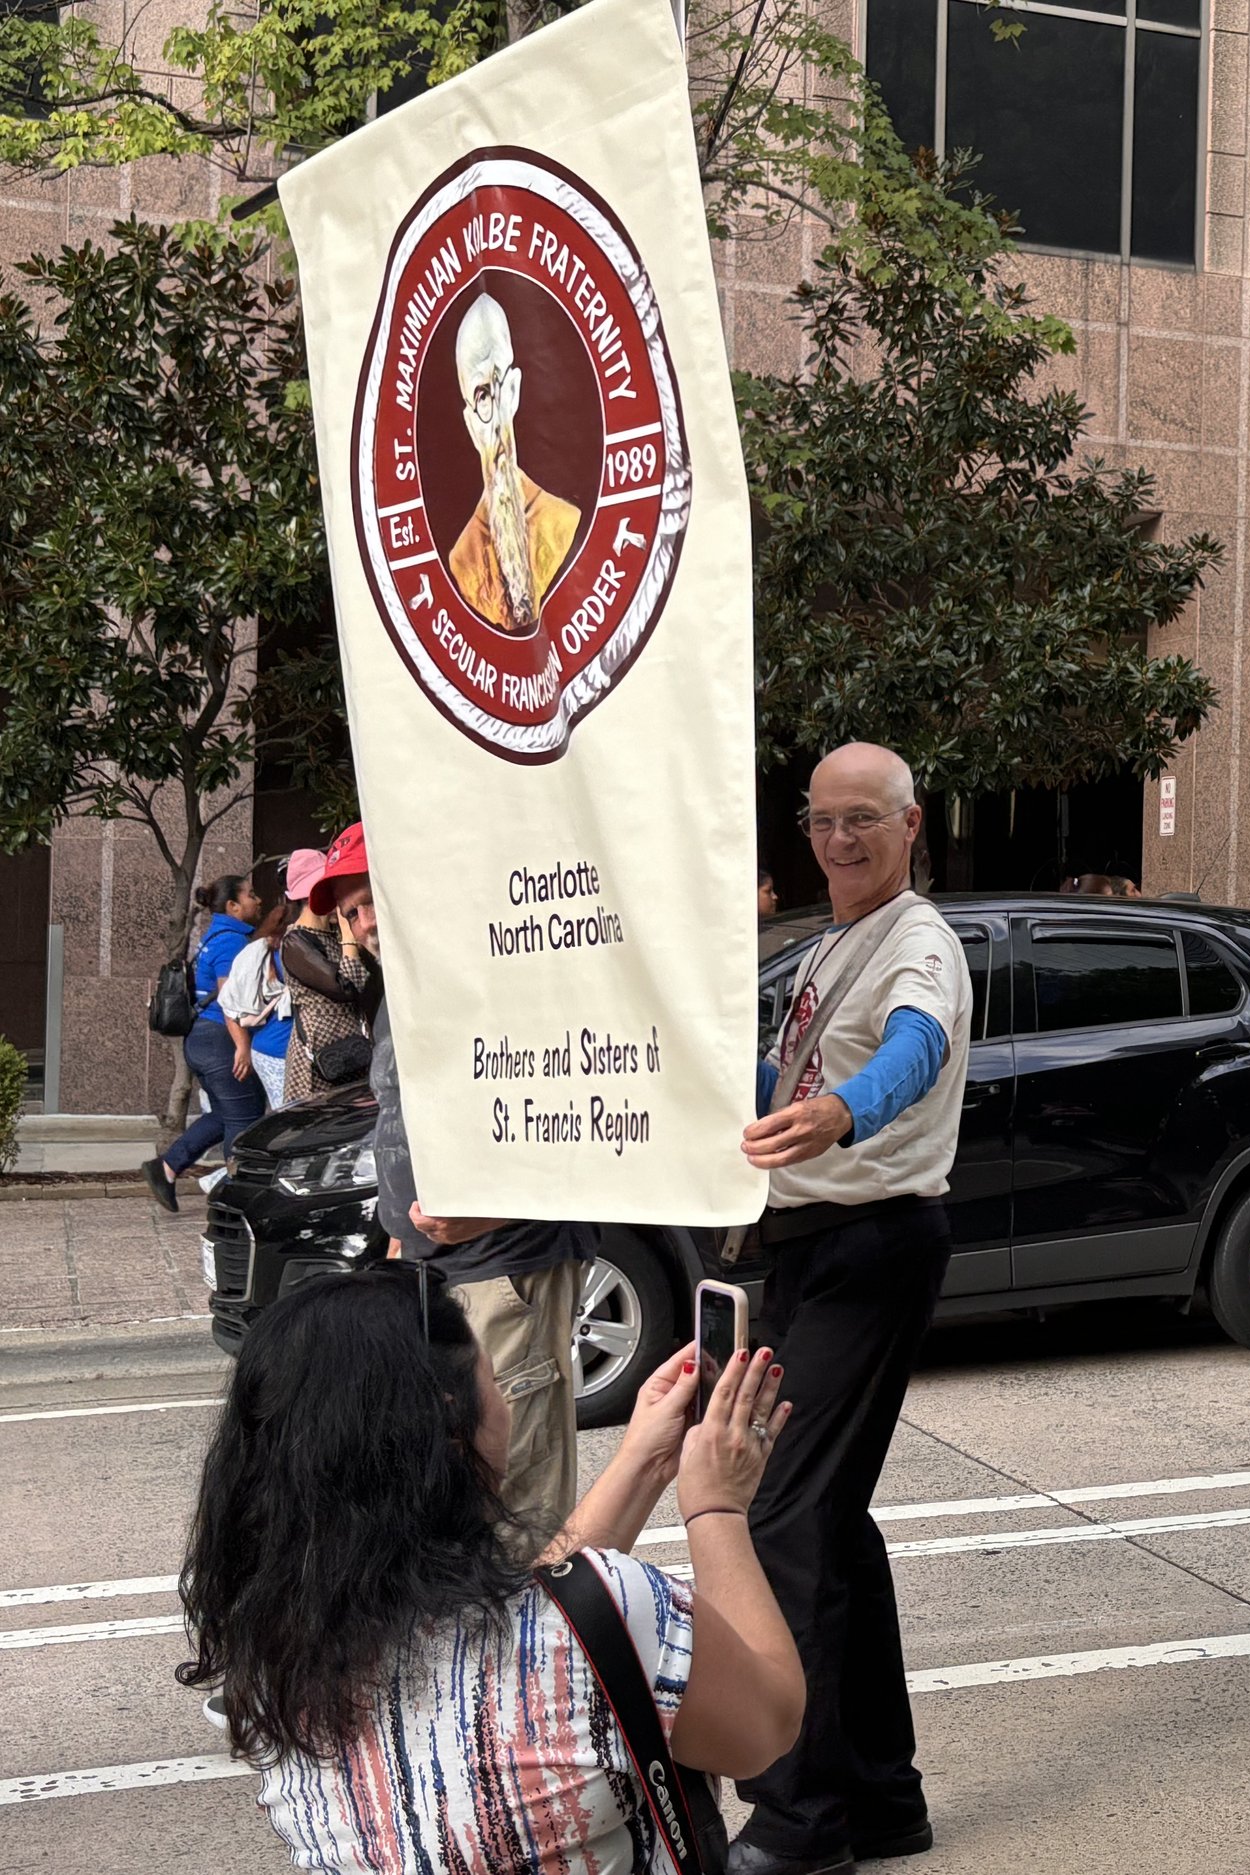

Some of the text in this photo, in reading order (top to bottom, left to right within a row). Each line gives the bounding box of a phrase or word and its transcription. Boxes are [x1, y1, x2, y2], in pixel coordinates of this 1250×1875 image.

[395, 212, 638, 481] ST. MAXIMILIAN KOLBE FRATERNITY
[390, 442, 658, 549] Est. 1989
[431, 606, 498, 698] SECULAR
[560, 561, 627, 654] ORDER
[508, 861, 600, 906] Charlotte
[489, 906, 624, 957] North Carolina
[473, 1025, 661, 1080] Brothers and Sisters of
[492, 1096, 650, 1157] St. Francis Region
[649, 1760, 687, 1860] Canon
